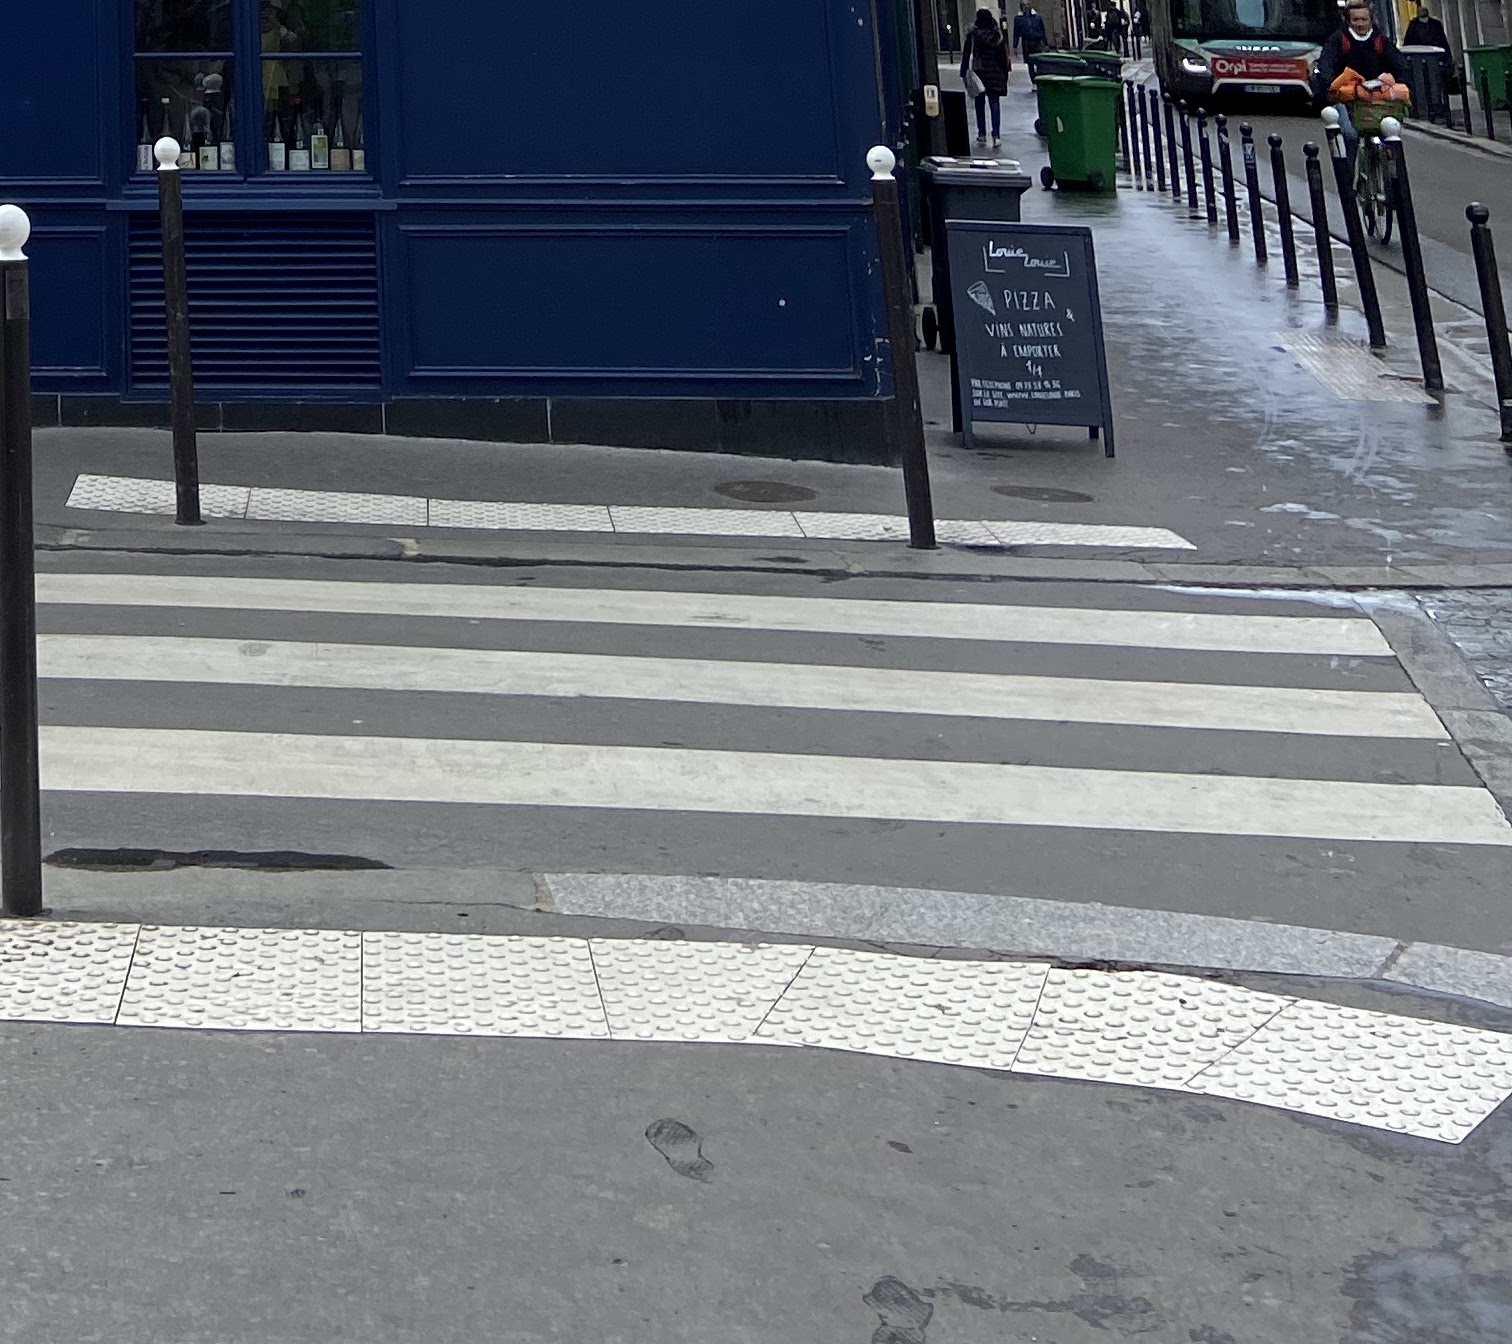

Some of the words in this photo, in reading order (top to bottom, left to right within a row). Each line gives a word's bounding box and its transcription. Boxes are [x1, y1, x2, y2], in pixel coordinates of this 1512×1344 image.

[1215, 59, 1246, 74] Orpi
[989, 240, 1028, 257] Louie
[1003, 289, 1056, 311] PIZZA
[985, 322, 1014, 338] VINS
[1019, 322, 1064, 338] NATURES
[1013, 343, 1062, 358] EMPORTER
